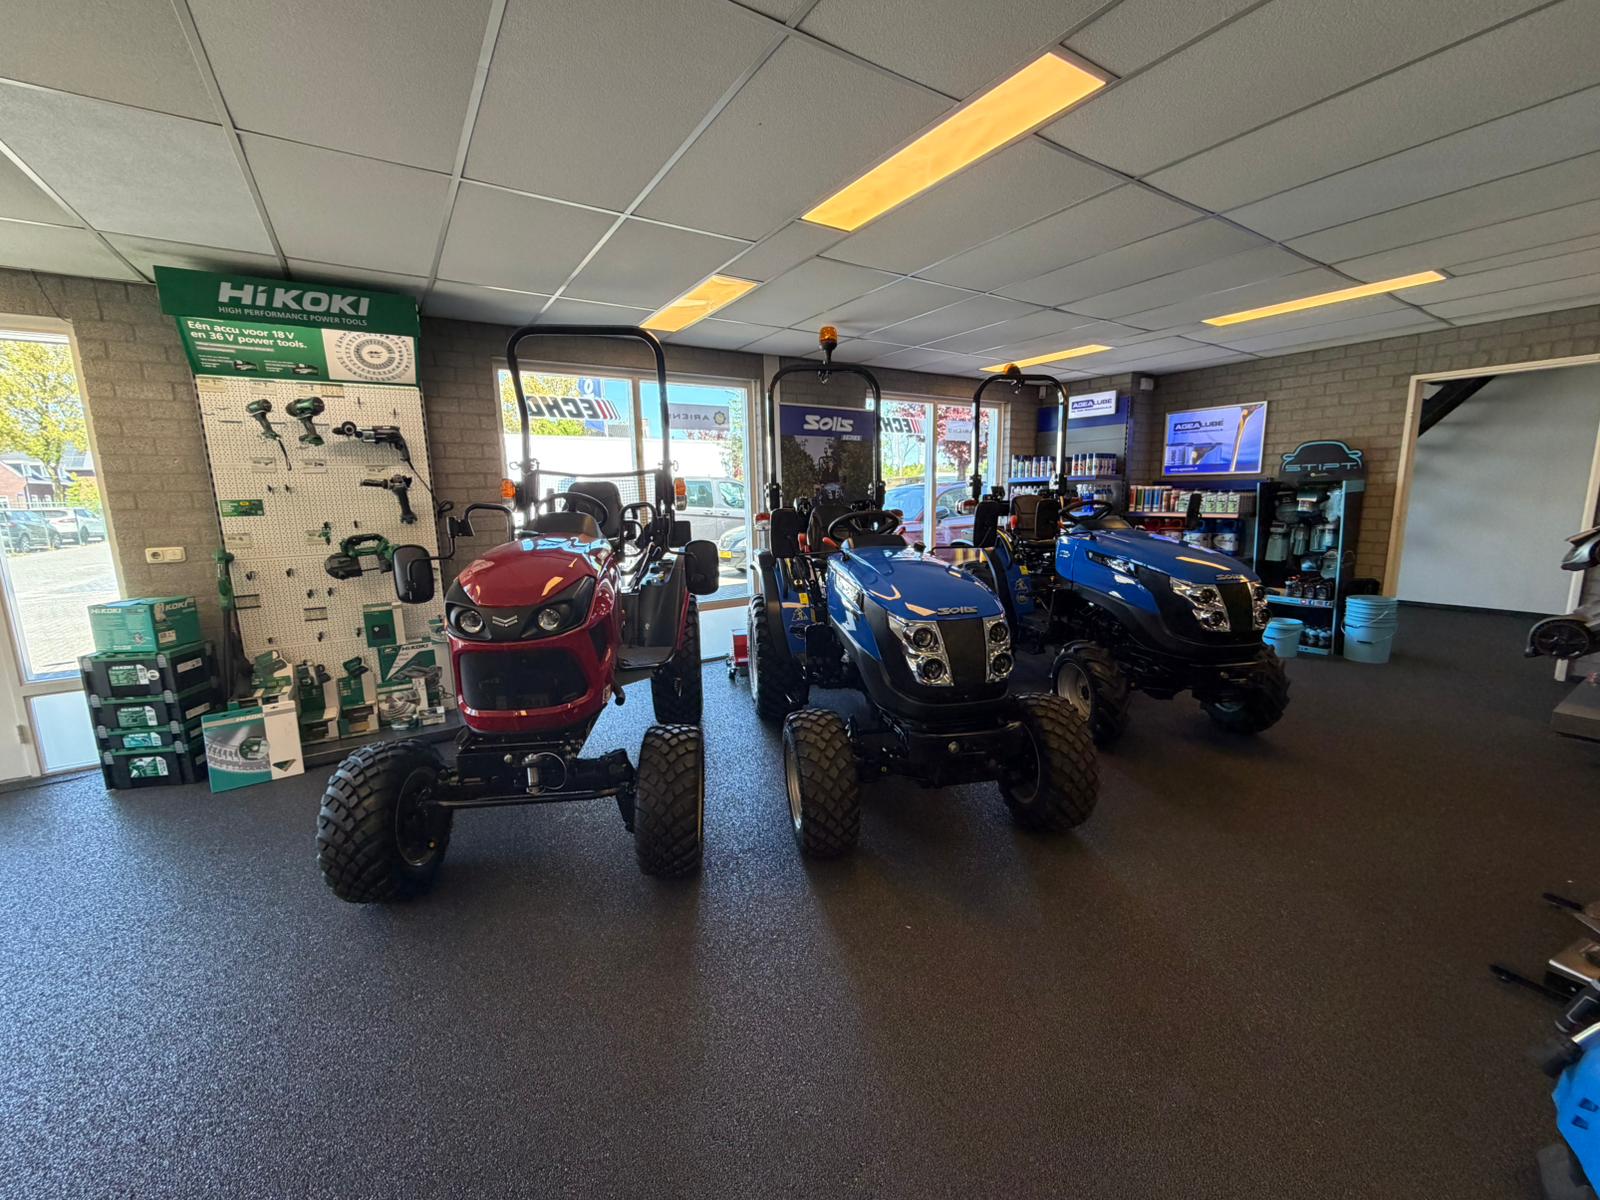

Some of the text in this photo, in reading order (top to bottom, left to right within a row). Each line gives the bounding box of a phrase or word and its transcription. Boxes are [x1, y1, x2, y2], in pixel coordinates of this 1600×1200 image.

[218, 281, 370, 317] HiKOKI
[218, 306, 368, 327] HIGH PERFORMANCE POWER TOOLS
[190, 331, 206, 339] en
[209, 332, 224, 341] 36
[225, 333, 234, 342] V
[238, 336, 274, 346] power
[277, 339, 308, 349] tools.
[213, 324, 240, 334] accu
[242, 328, 269, 337] voor
